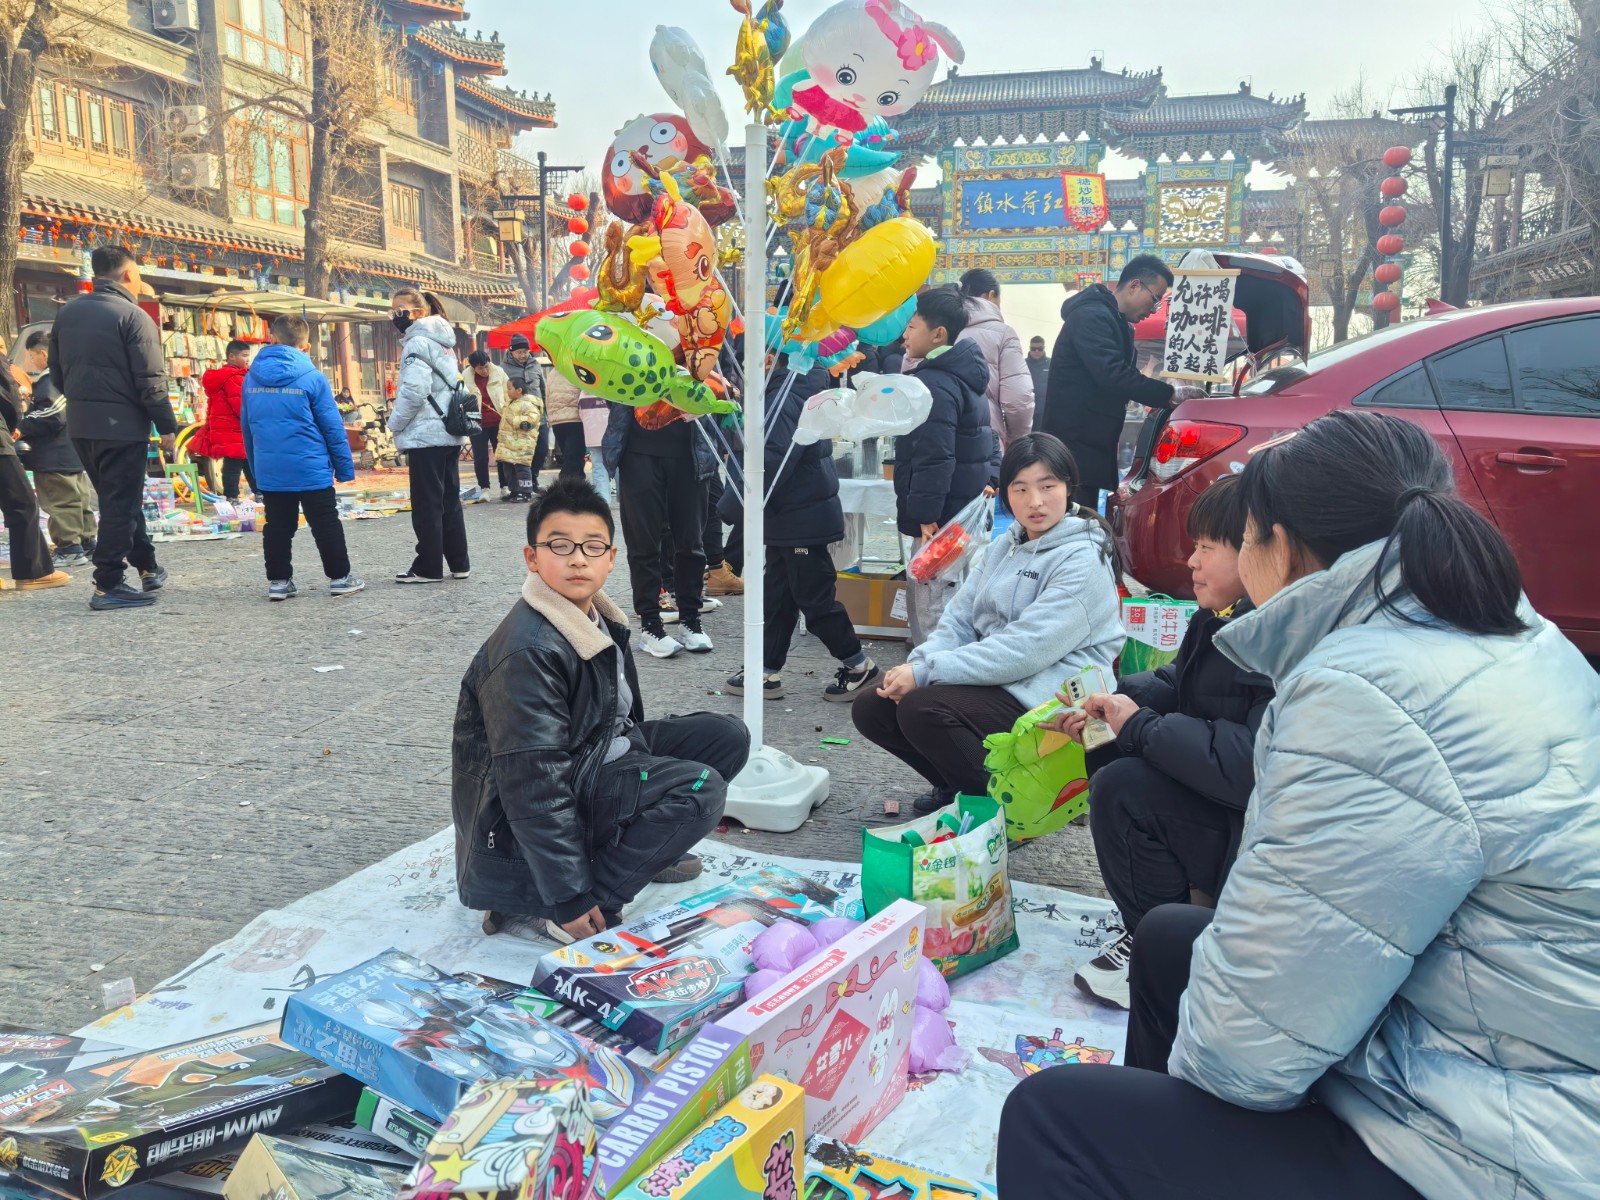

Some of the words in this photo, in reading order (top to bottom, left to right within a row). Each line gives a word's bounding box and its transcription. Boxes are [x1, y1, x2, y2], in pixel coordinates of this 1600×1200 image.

[1173, 275, 1230, 309] 允许喝
[1170, 304, 1228, 336] 咖啡
[1168, 332, 1218, 355] 的人先
[1166, 352, 1218, 376] 富起来
[1161, 607, 1178, 647] 纯牛奶
[628, 917, 660, 935] COMBAT
[635, 959, 715, 997] AK-47
[559, 981, 626, 1024] AK-47
[293, 1015, 381, 1084] 宇宙之光
[599, 1091, 678, 1168] CARROT
[655, 1038, 731, 1096] PISTOL
